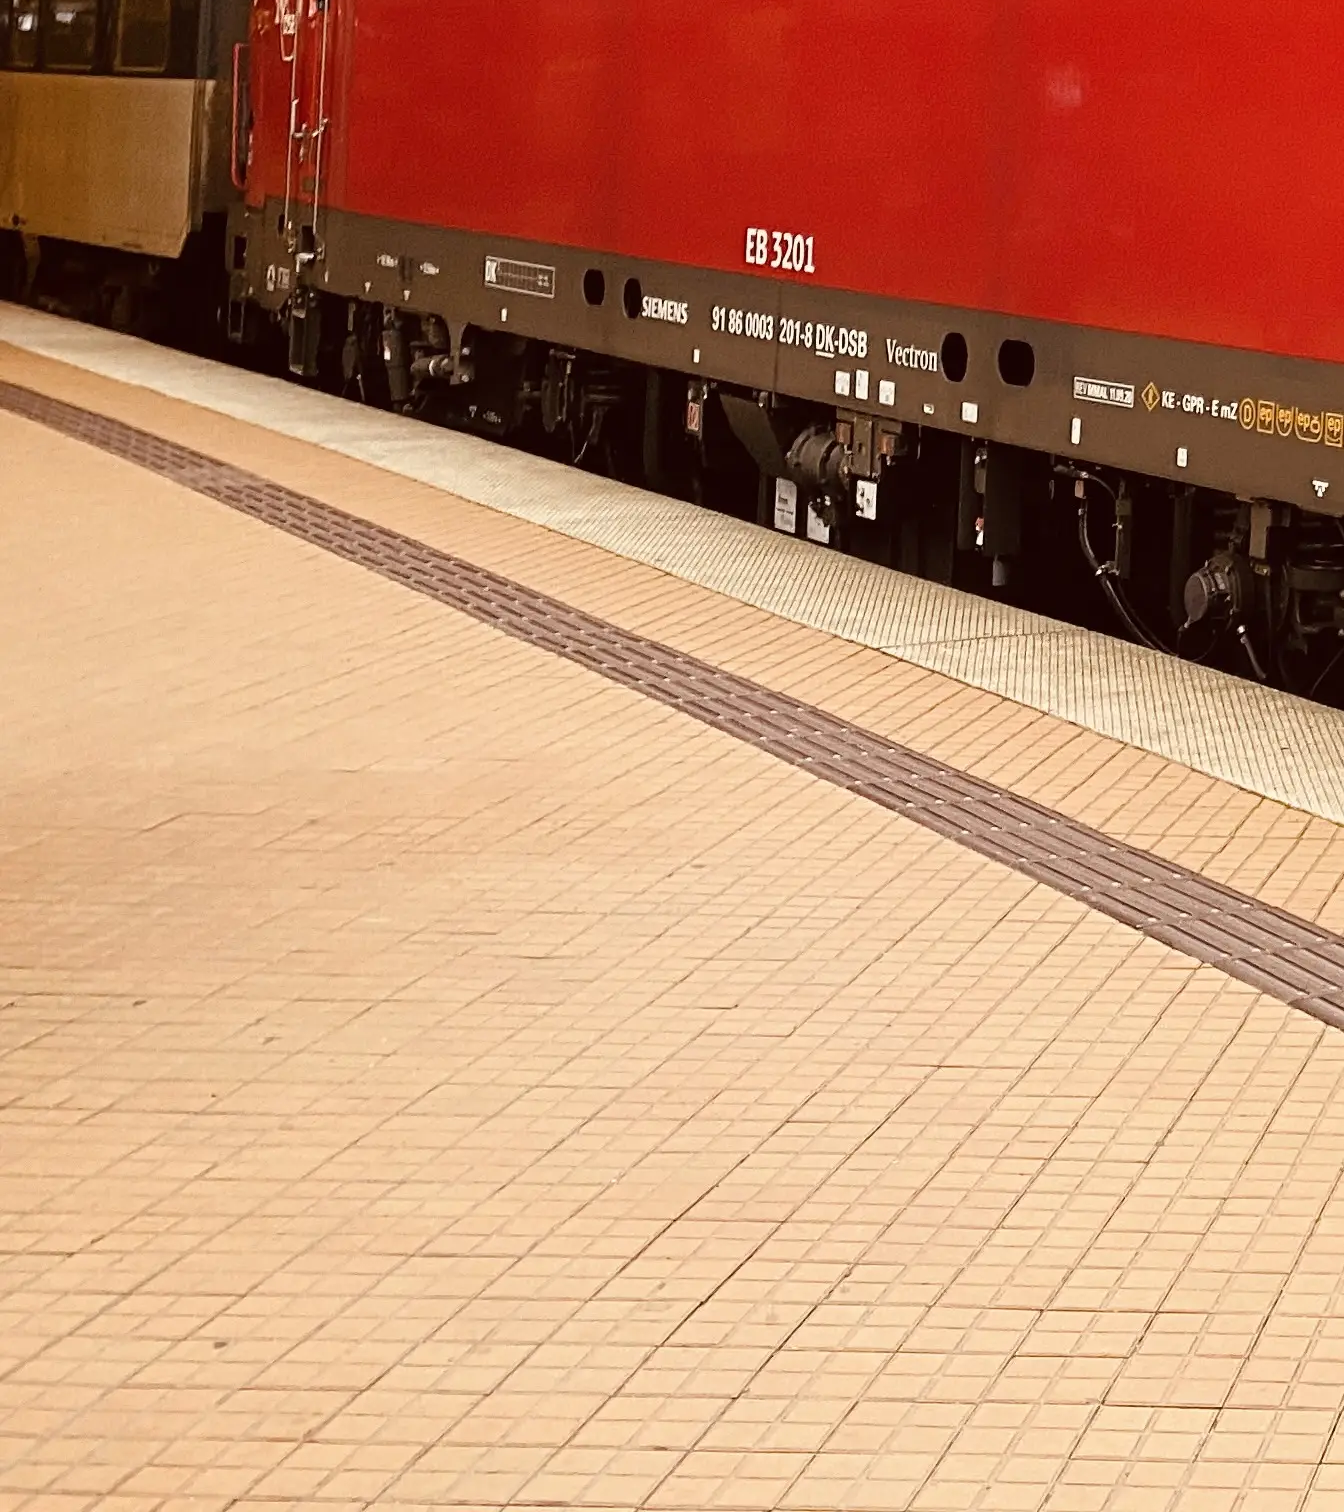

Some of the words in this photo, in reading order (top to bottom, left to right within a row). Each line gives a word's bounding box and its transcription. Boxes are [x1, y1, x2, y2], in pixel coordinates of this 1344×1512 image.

[745, 227, 768, 265] EB
[770, 231, 816, 274] 3201
[641, 295, 688, 325] SIEMENS
[711, 305, 726, 332] 91
[728, 308, 743, 335] 86
[745, 311, 774, 341] 0003
[778, 317, 813, 349] 201-8
[815, 323, 868, 359] DK-DSB
[886, 338, 938, 372] Vectron
